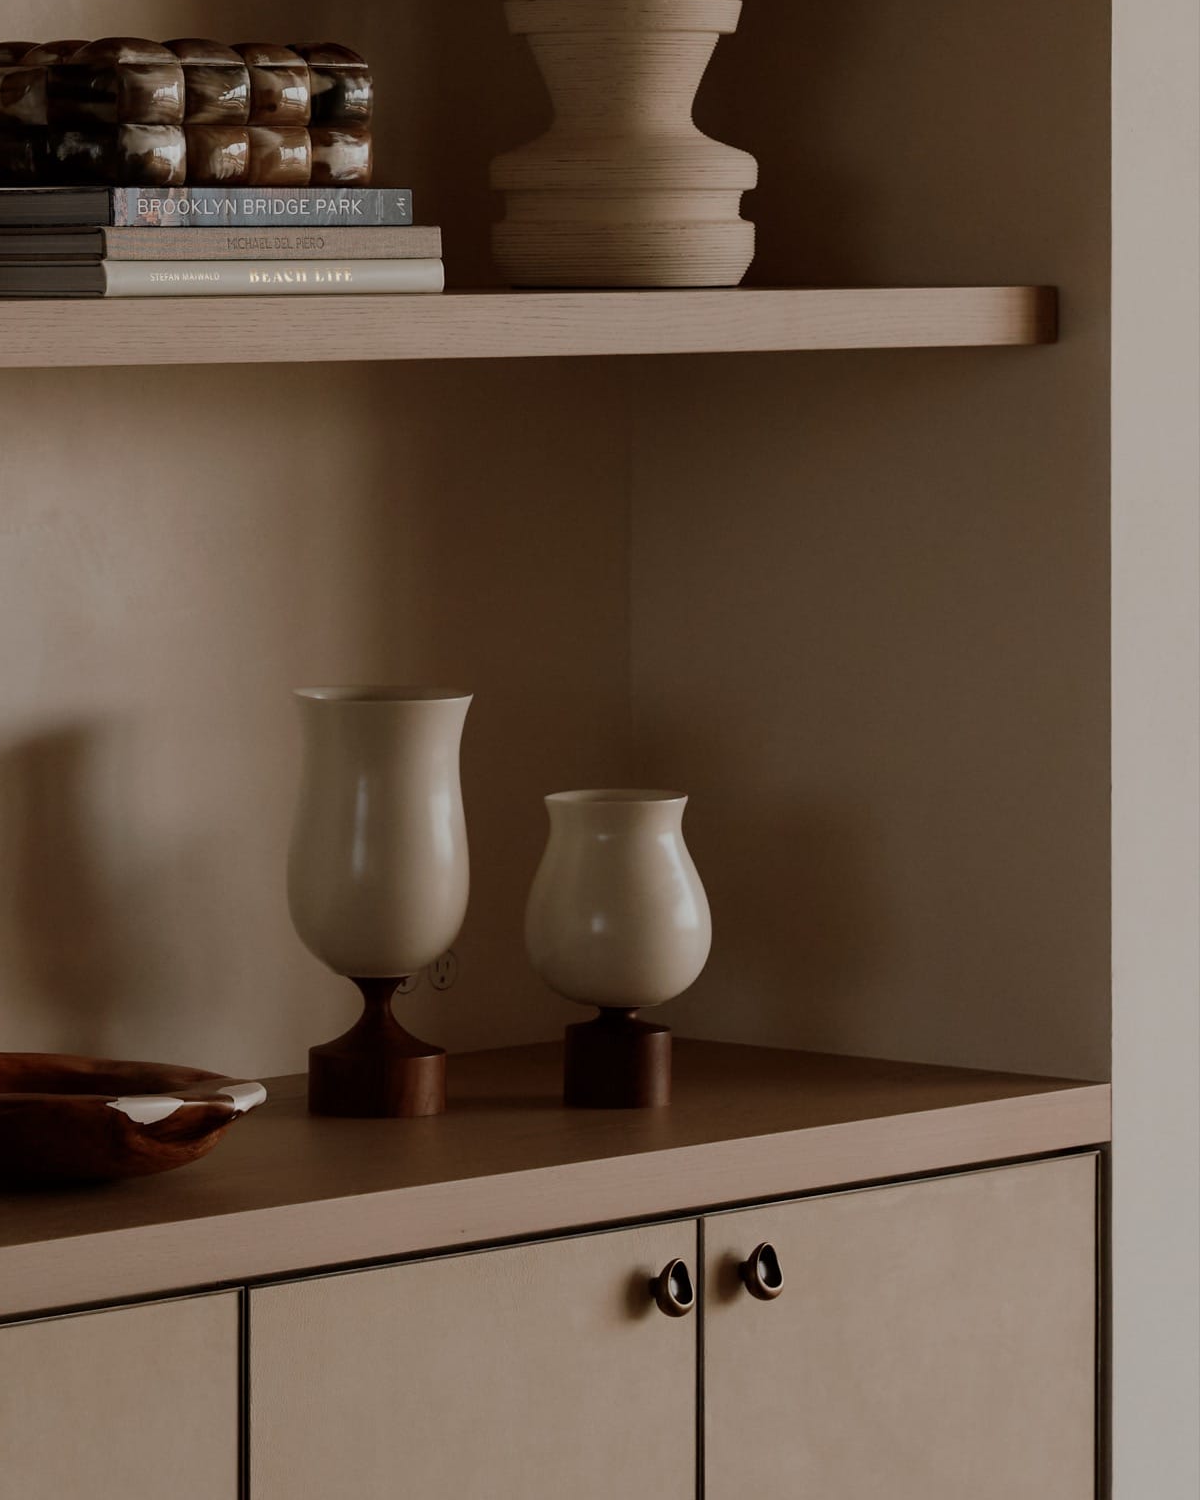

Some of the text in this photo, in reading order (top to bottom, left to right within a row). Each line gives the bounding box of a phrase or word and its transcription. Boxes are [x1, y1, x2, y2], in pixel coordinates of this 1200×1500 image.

[137, 198, 363, 215] BROOKLYN BRIDGE PARK
[227, 236, 325, 250] MICHAEL DEL PIERO
[150, 271, 220, 282] STEFAN MAIWALD
[249, 267, 353, 283] BEACH LIFE
